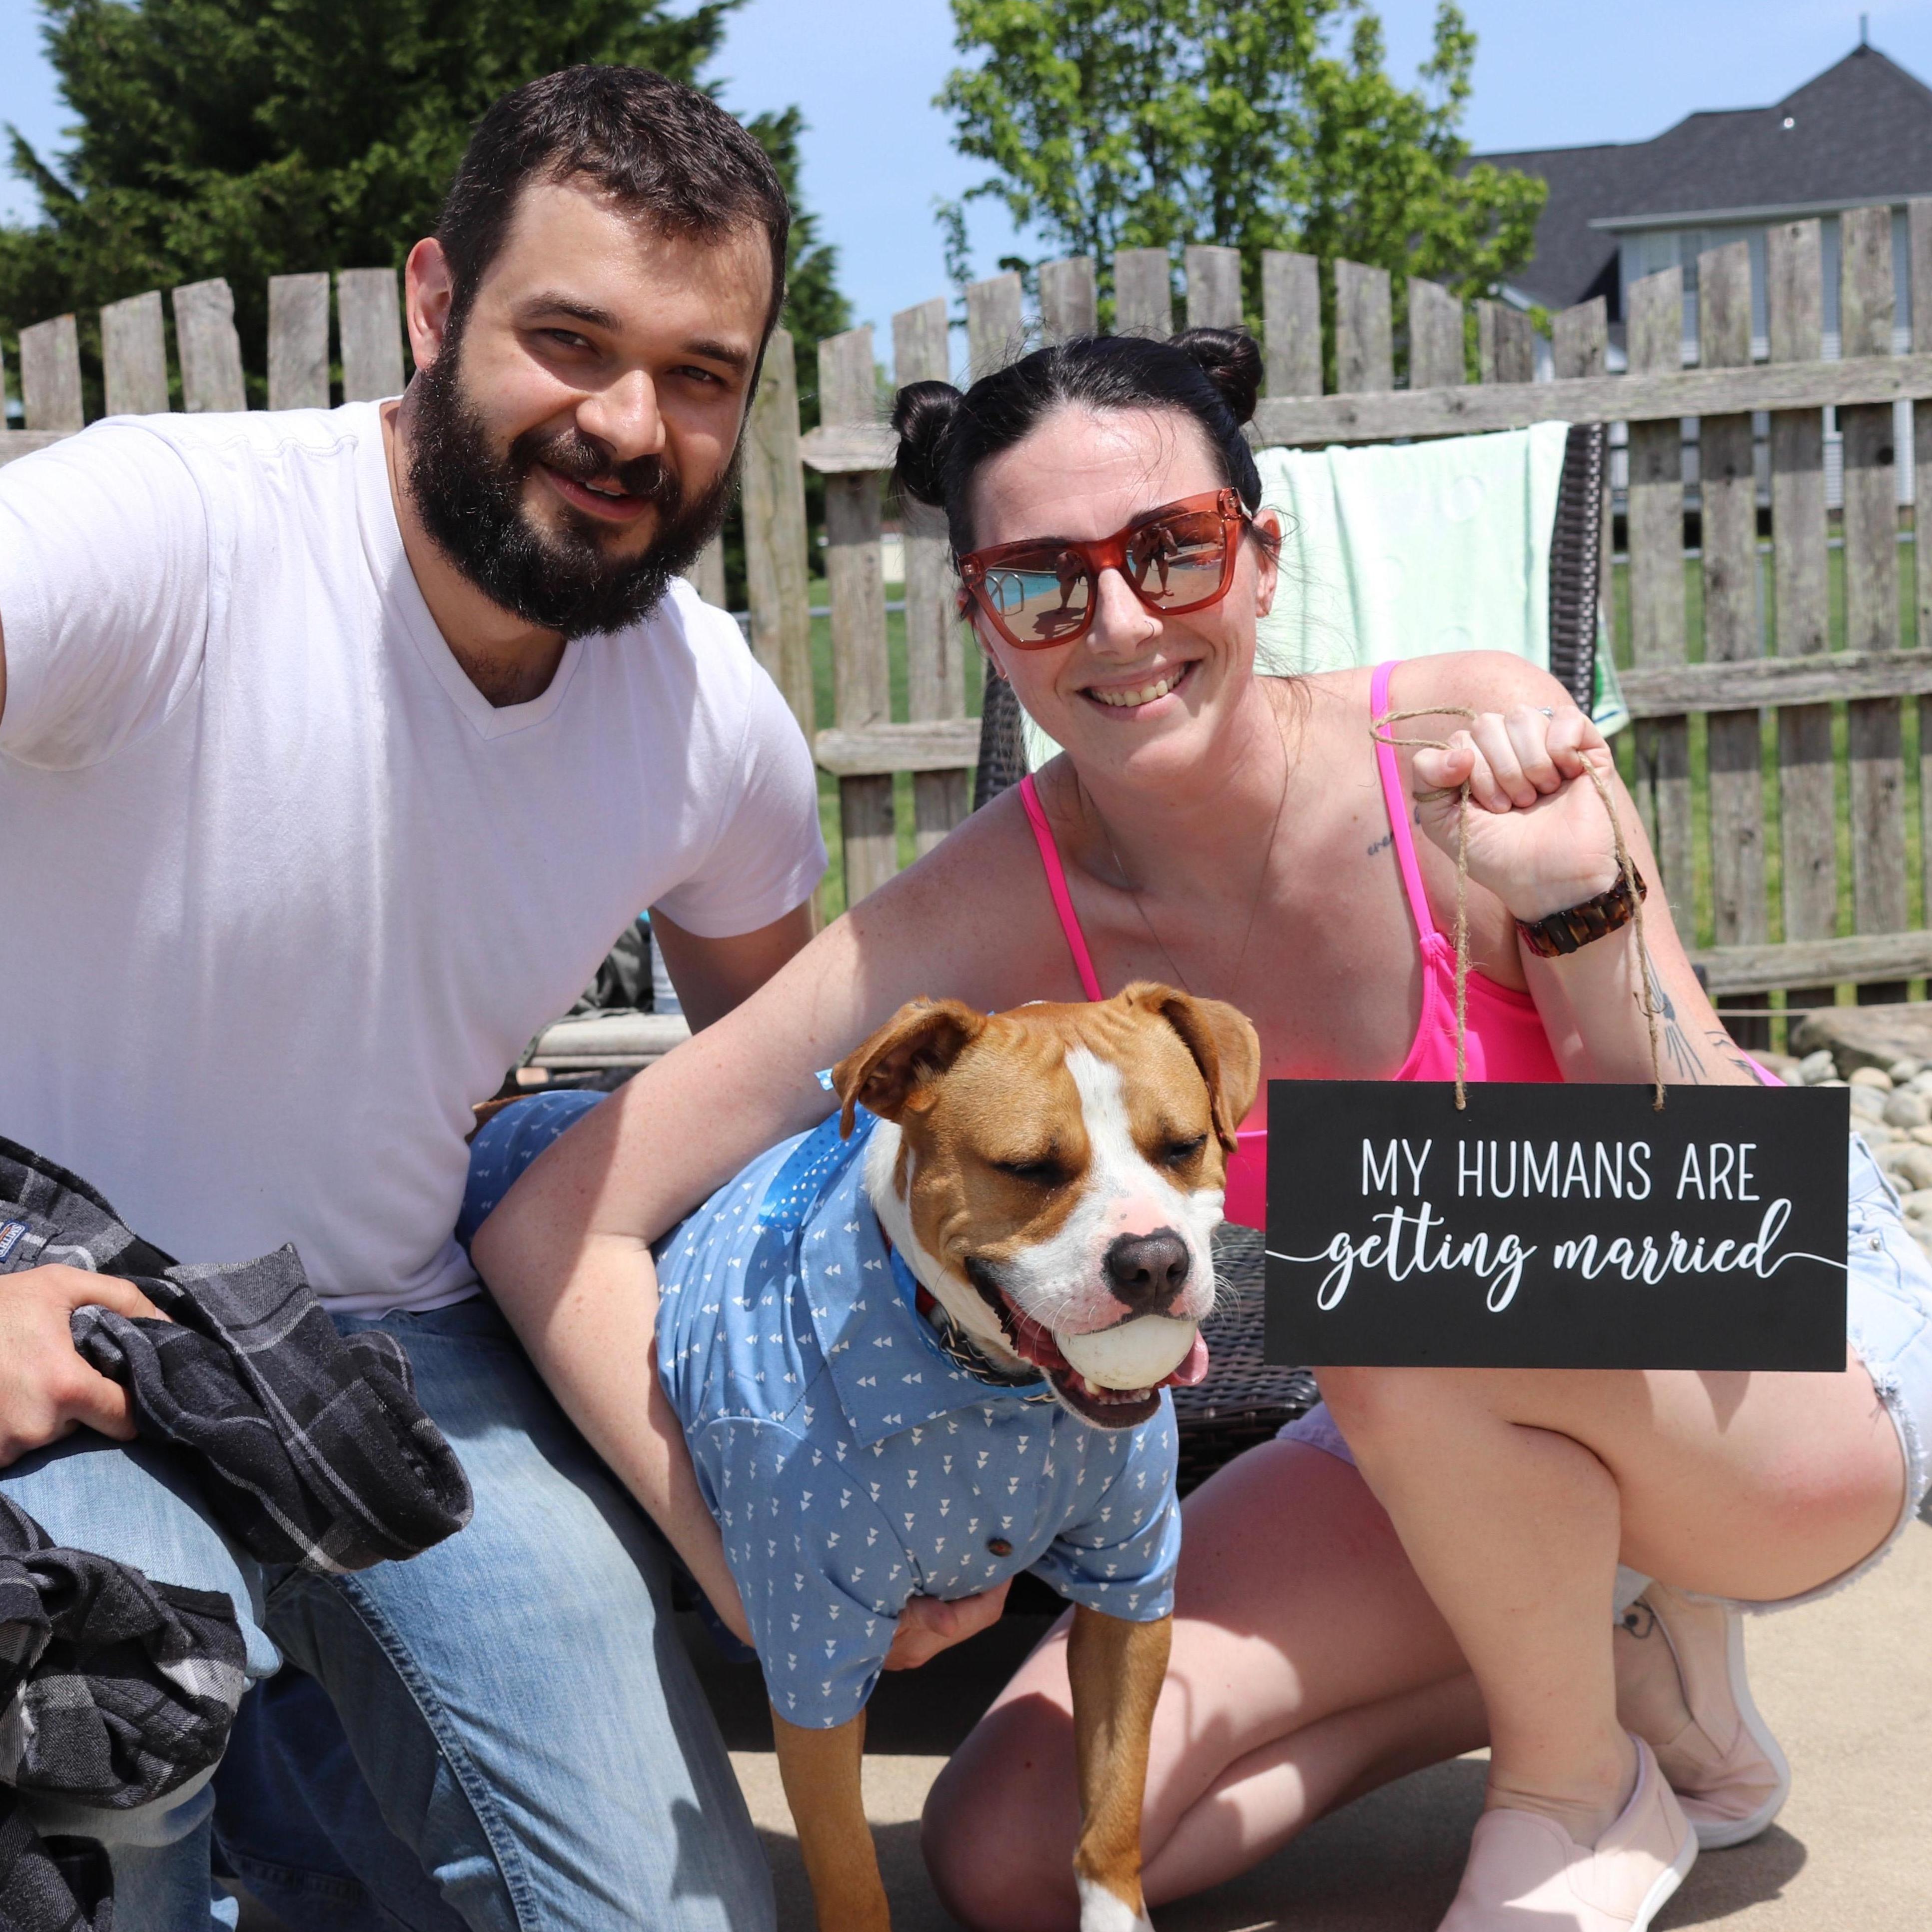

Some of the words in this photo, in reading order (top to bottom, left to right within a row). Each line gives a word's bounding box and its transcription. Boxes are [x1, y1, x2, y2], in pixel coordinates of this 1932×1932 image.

[1362, 1138, 1432, 1196] MY
[1458, 1140, 1651, 1200] HUMANS
[1676, 1142, 1760, 1201] ARE
[1265, 1201, 1538, 1312] getting
[1553, 1198, 1848, 1285] married
